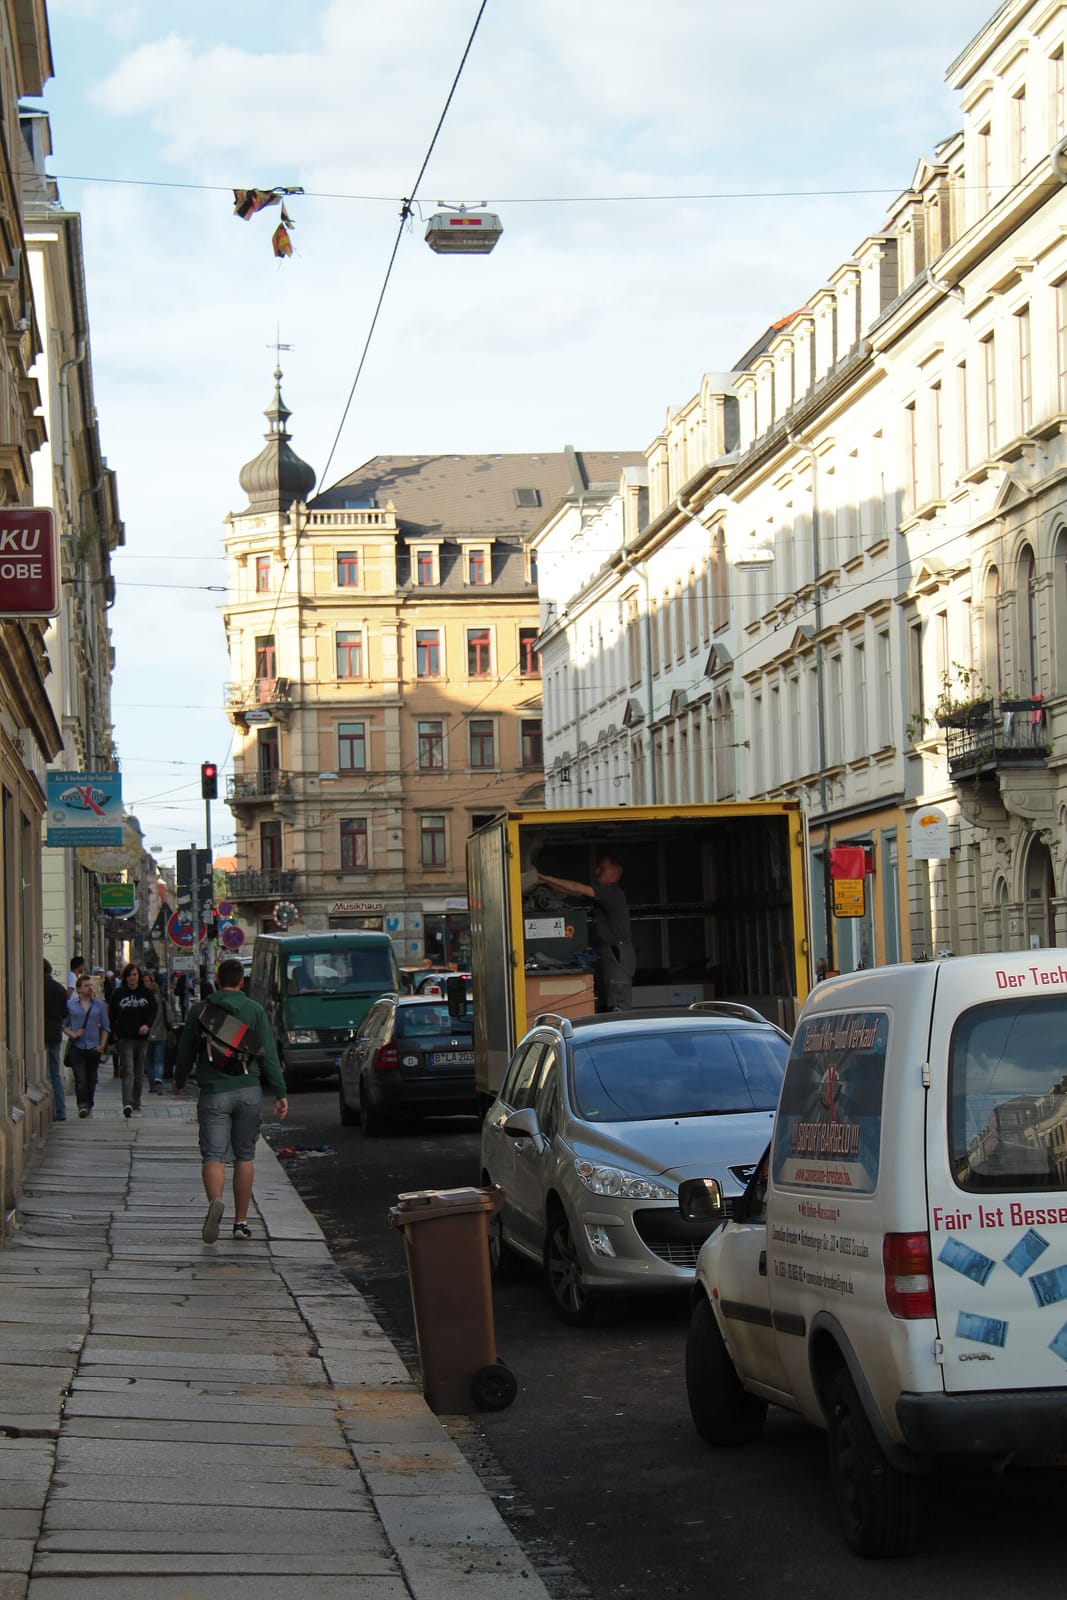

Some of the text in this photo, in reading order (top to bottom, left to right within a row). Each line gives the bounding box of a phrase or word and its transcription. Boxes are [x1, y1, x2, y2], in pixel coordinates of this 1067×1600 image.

[0, 529, 40, 551] KU
[1, 564, 42, 579] OBE
[332, 902, 384, 912] Musikhaus
[996, 971, 1025, 989] Der
[849, 1018, 879, 1049] Verkauf
[798, 1122, 821, 1151] SOFORT
[820, 1122, 851, 1153] BARGELD
[933, 1202, 1067, 1231] Fair Ist Besse
[959, 1352, 995, 1362] OPEL
